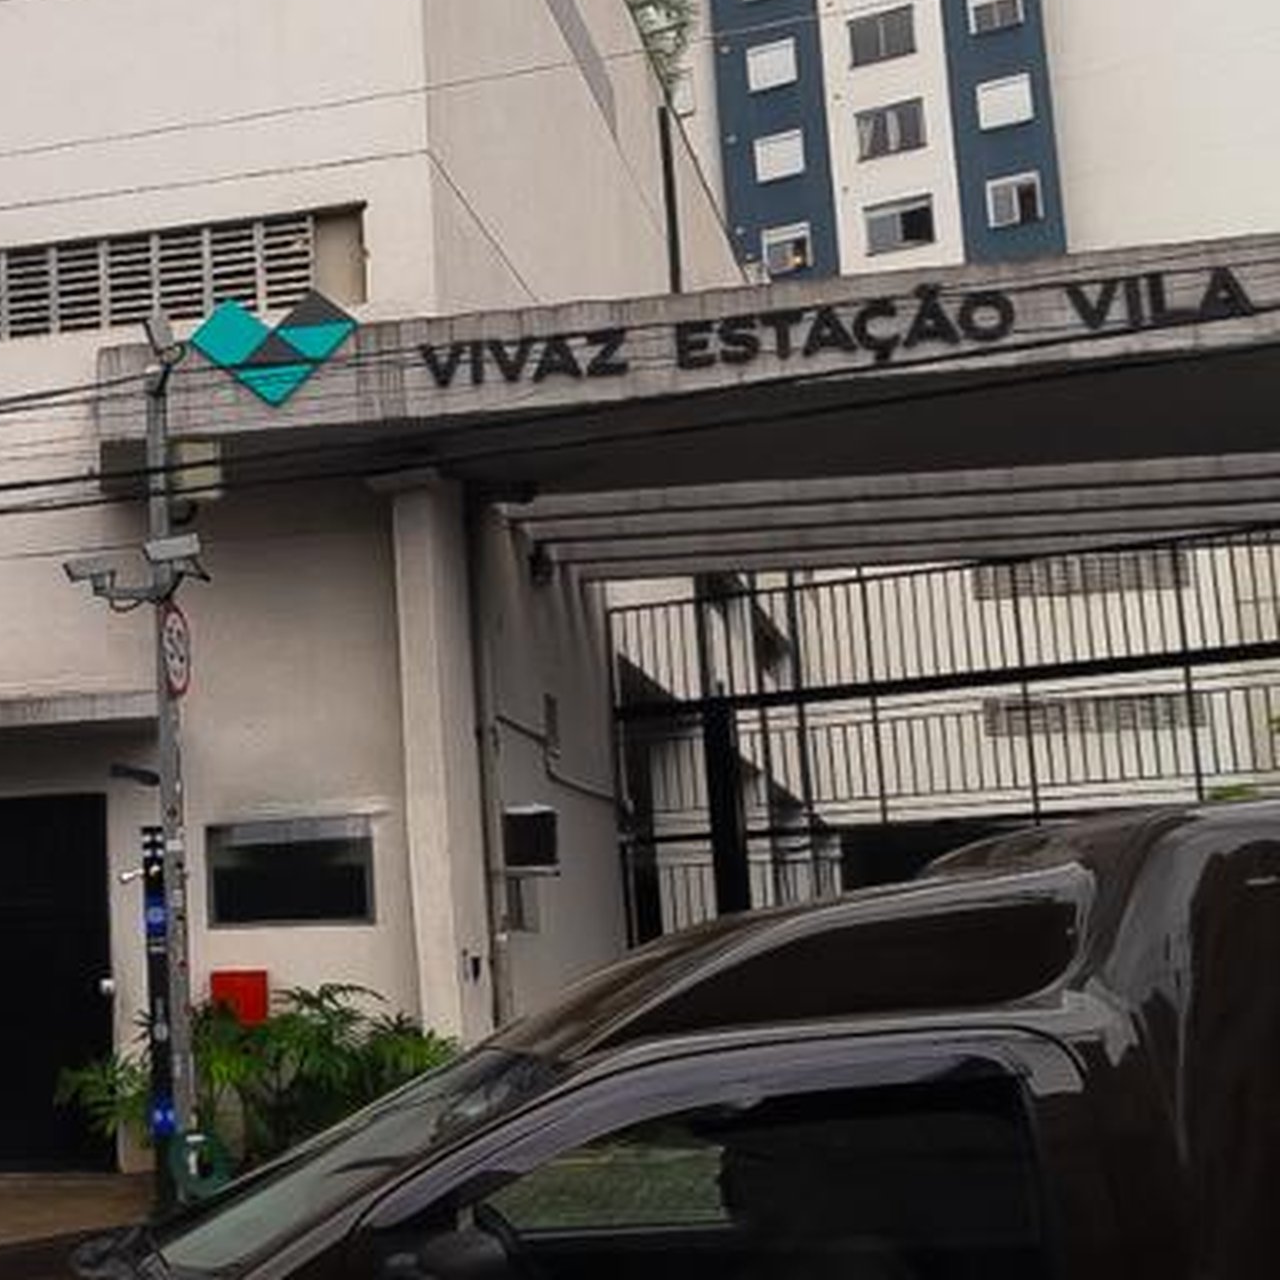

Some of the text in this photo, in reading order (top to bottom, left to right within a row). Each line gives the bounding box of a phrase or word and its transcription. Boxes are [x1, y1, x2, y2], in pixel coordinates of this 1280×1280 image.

[418, 267, 1254, 388] VIVAZ ESTAÇÃO VILA
